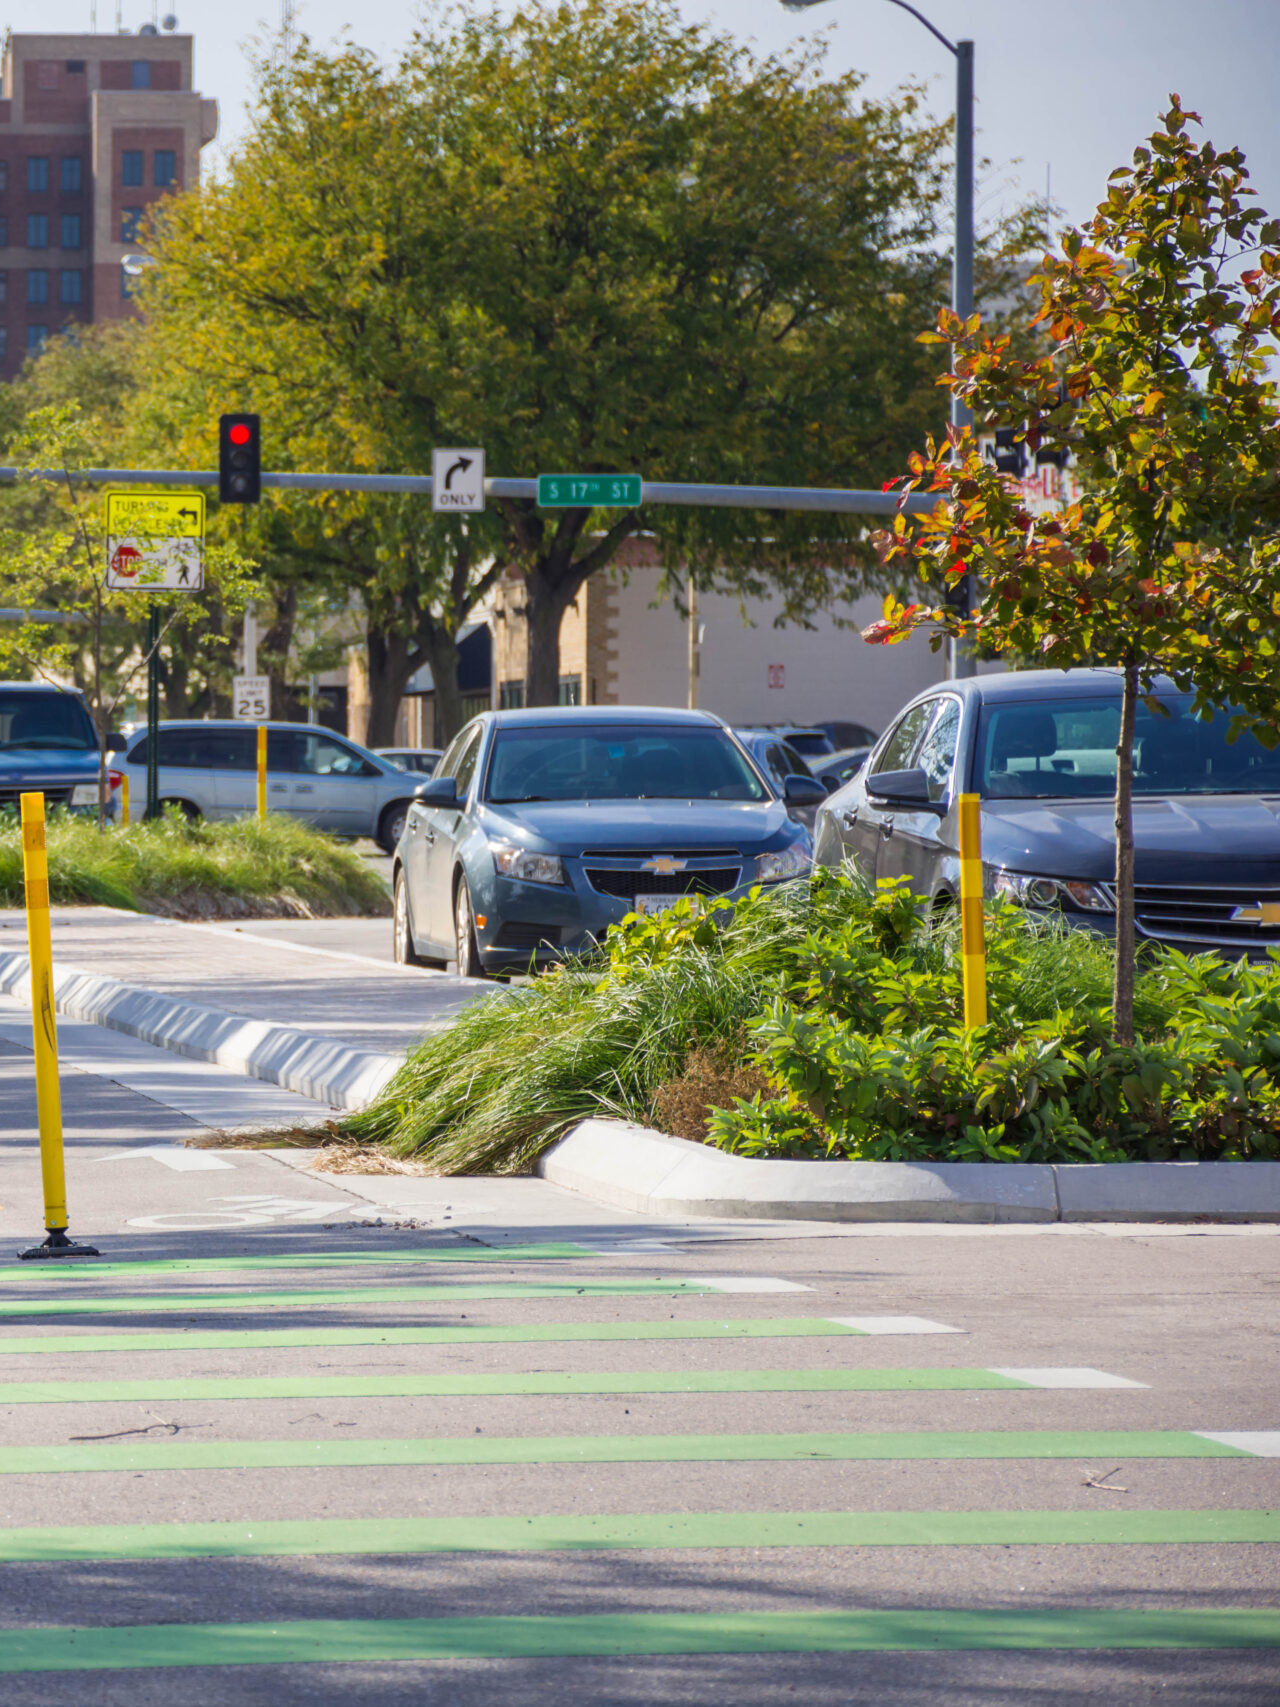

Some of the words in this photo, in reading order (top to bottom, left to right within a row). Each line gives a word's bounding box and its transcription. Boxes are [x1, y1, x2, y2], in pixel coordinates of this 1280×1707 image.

[549, 482, 559, 499] S
[612, 482, 630, 499] ST
[440, 494, 476, 505] ONLY
[238, 699, 266, 716] 25
